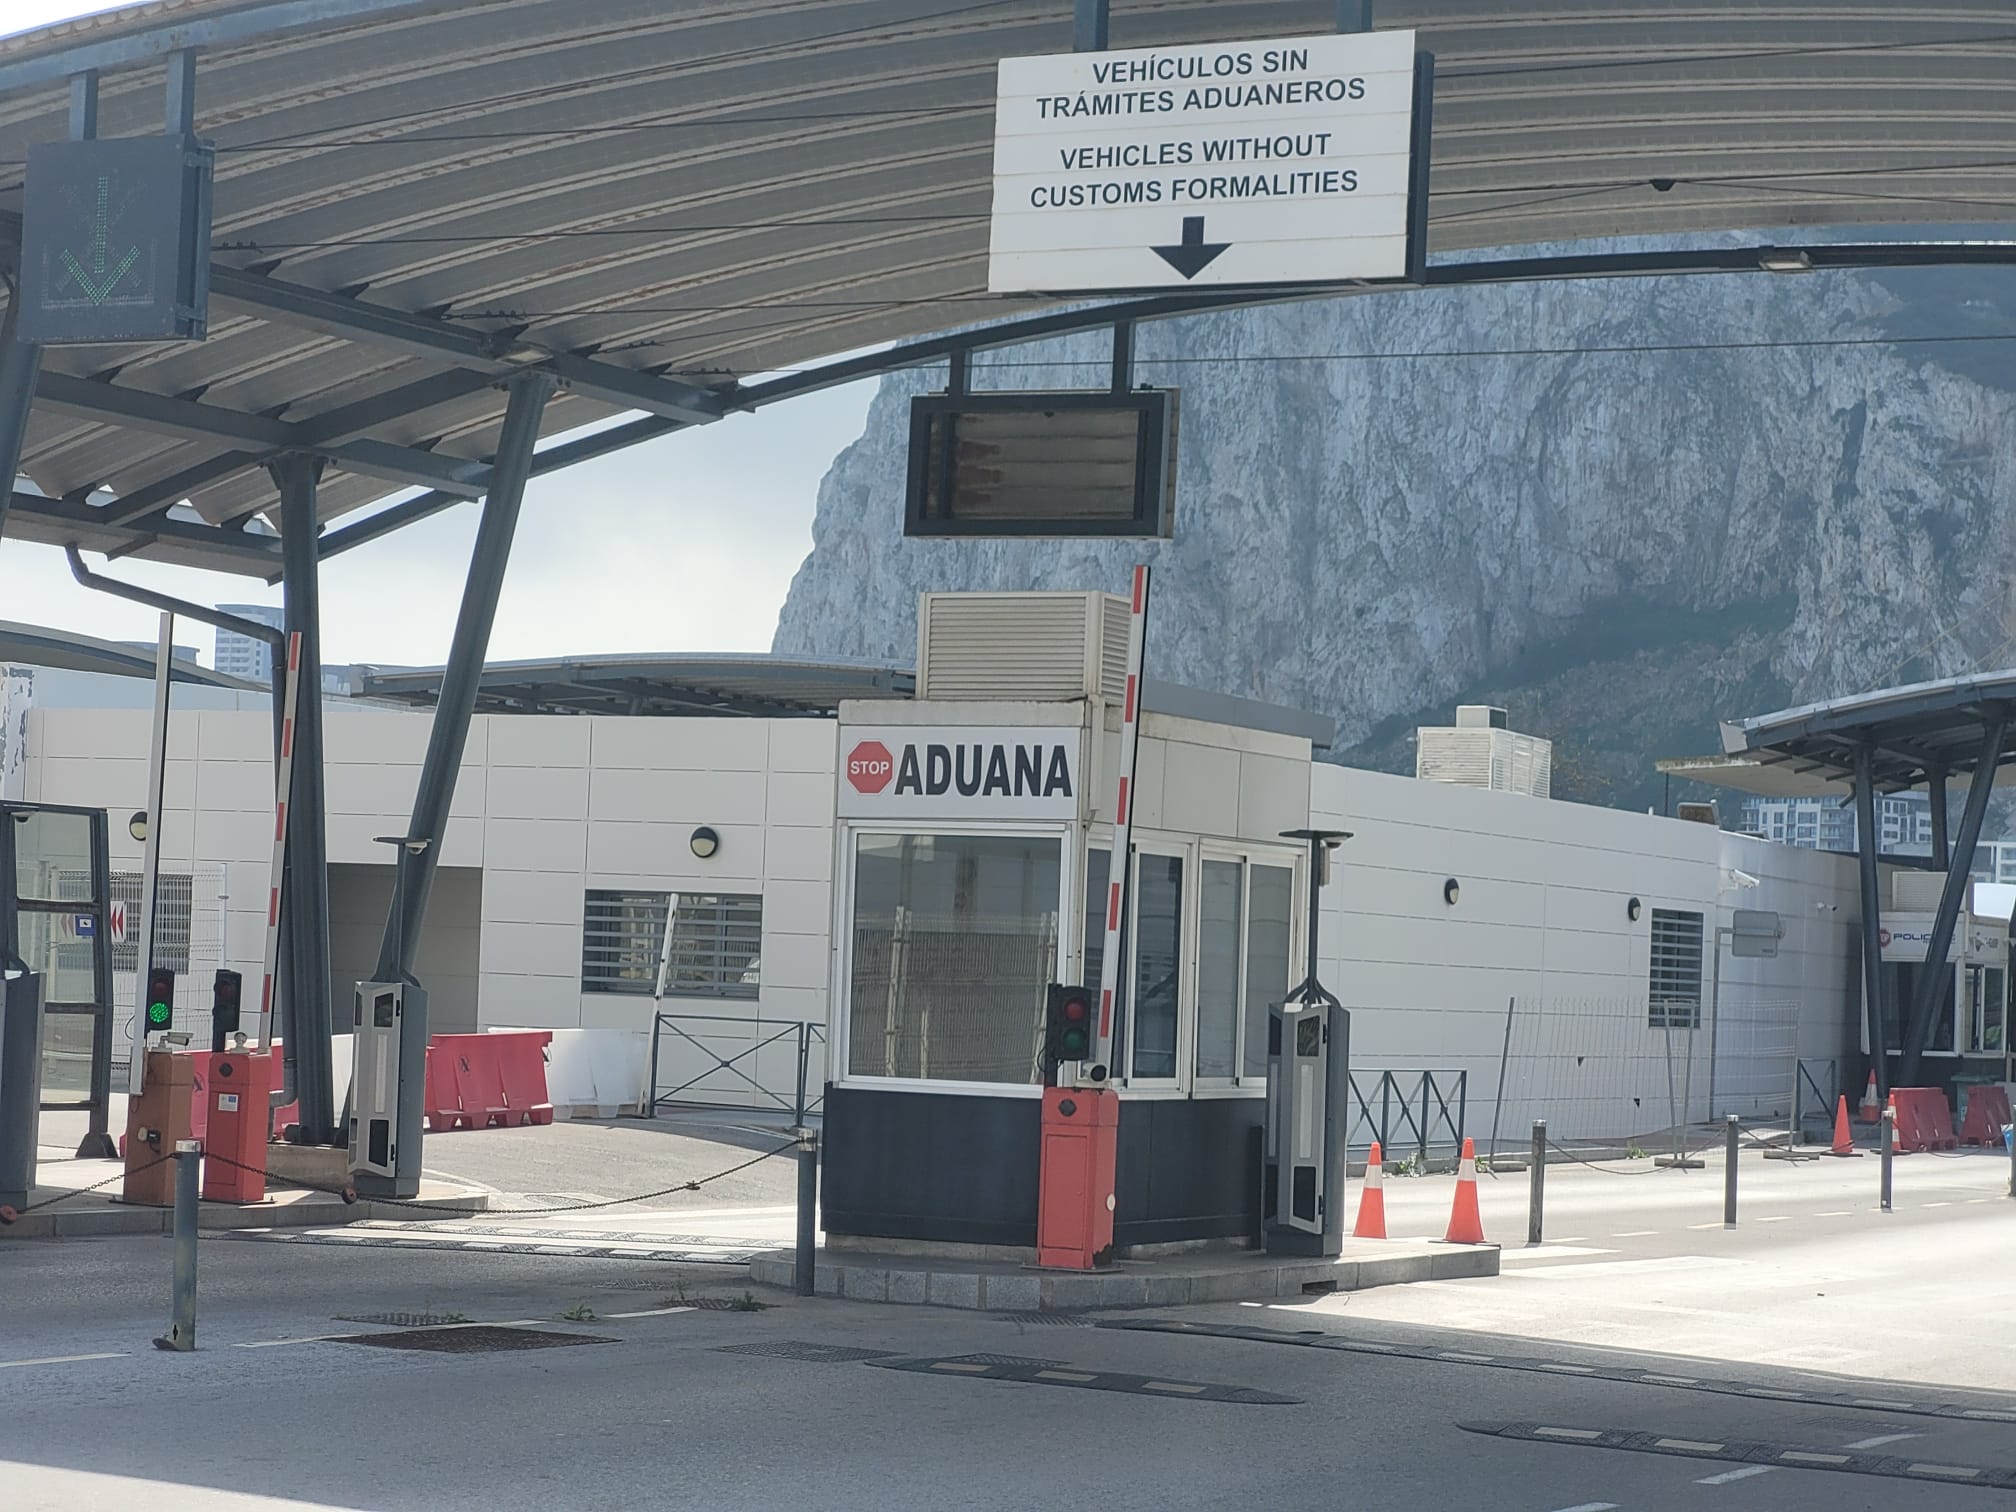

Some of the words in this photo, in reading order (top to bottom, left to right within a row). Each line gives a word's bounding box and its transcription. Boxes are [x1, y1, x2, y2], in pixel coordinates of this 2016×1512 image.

[1092, 53, 1253, 84] VEHÍCULOS
[1263, 48, 1308, 73] SIN
[1036, 89, 1174, 119] TRÁMITES
[1182, 77, 1365, 110] ADUANEROS
[1060, 141, 1193, 170] VEHICLES
[1202, 133, 1332, 162] WITHOUT
[1030, 179, 1162, 208] CUSTOMS
[1171, 168, 1358, 201] FORMALITIES
[850, 760, 889, 775] STOP
[894, 743, 1073, 797] ADUANA
